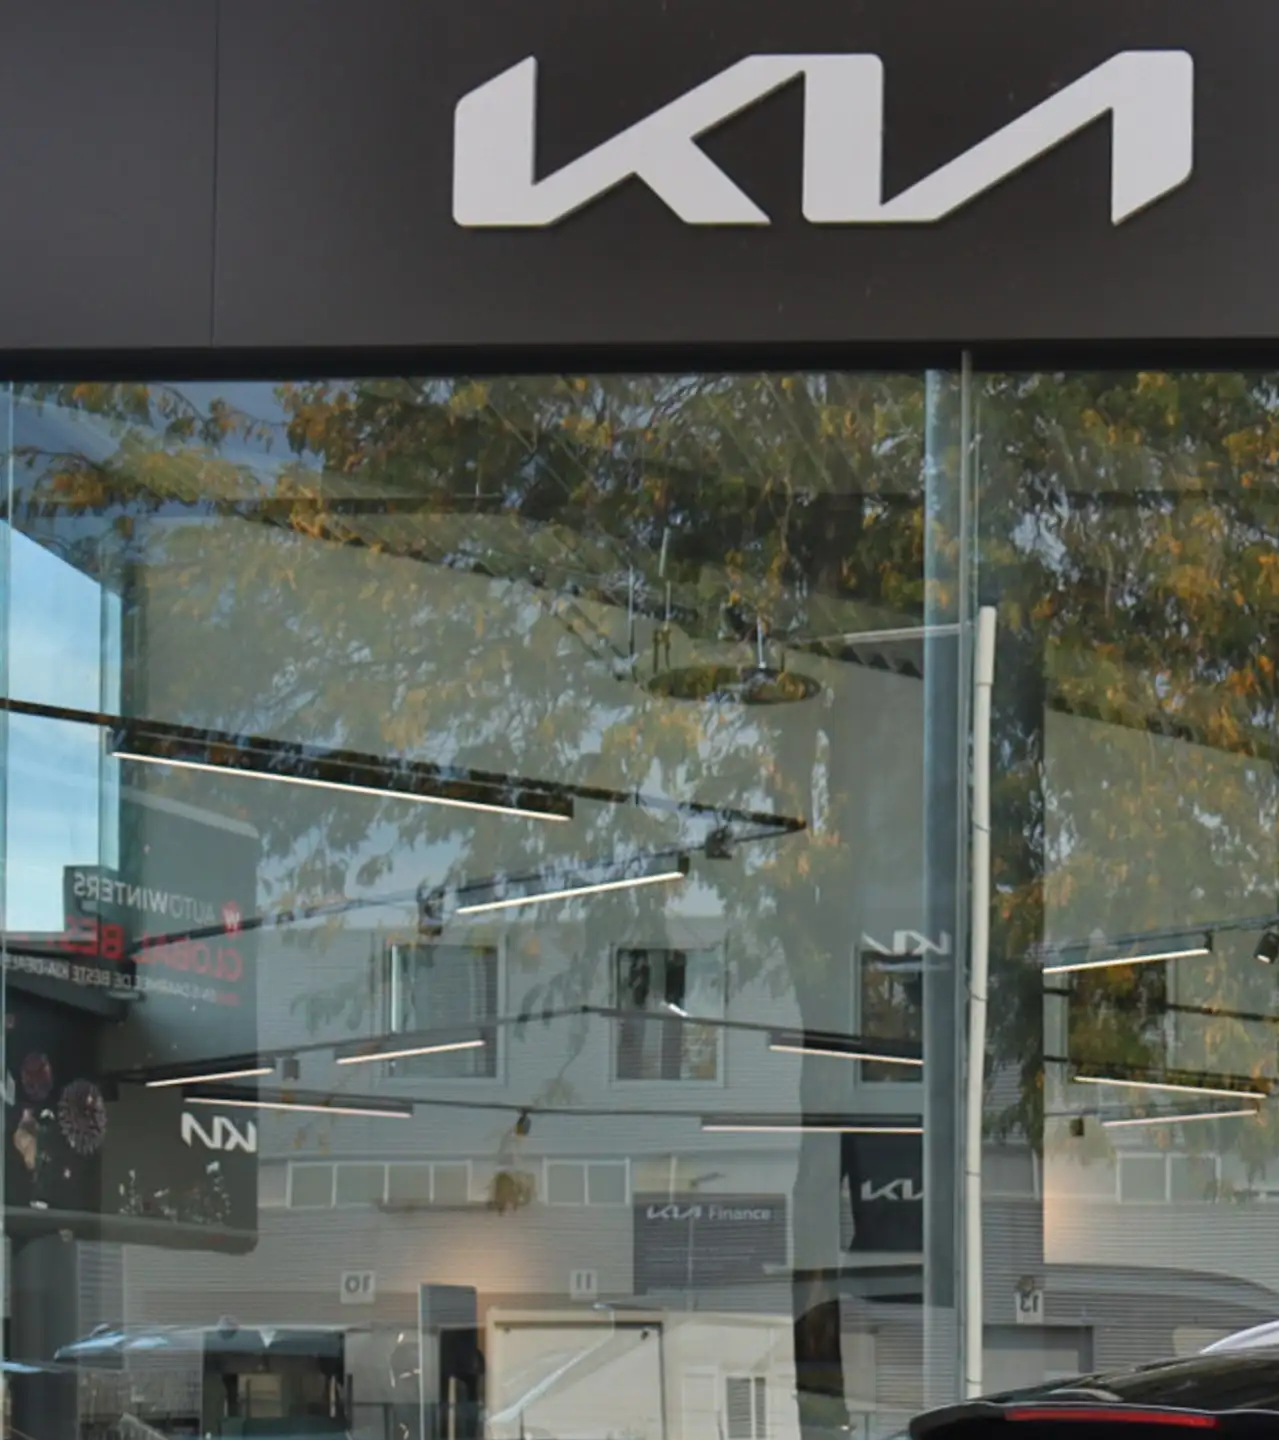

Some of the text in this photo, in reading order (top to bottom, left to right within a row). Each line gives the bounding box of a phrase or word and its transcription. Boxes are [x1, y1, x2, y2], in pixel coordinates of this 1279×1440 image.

[452, 50, 1194, 226] KIA
[861, 1179, 923, 1200] KI
[647, 1205, 770, 1220] KIA Finance
